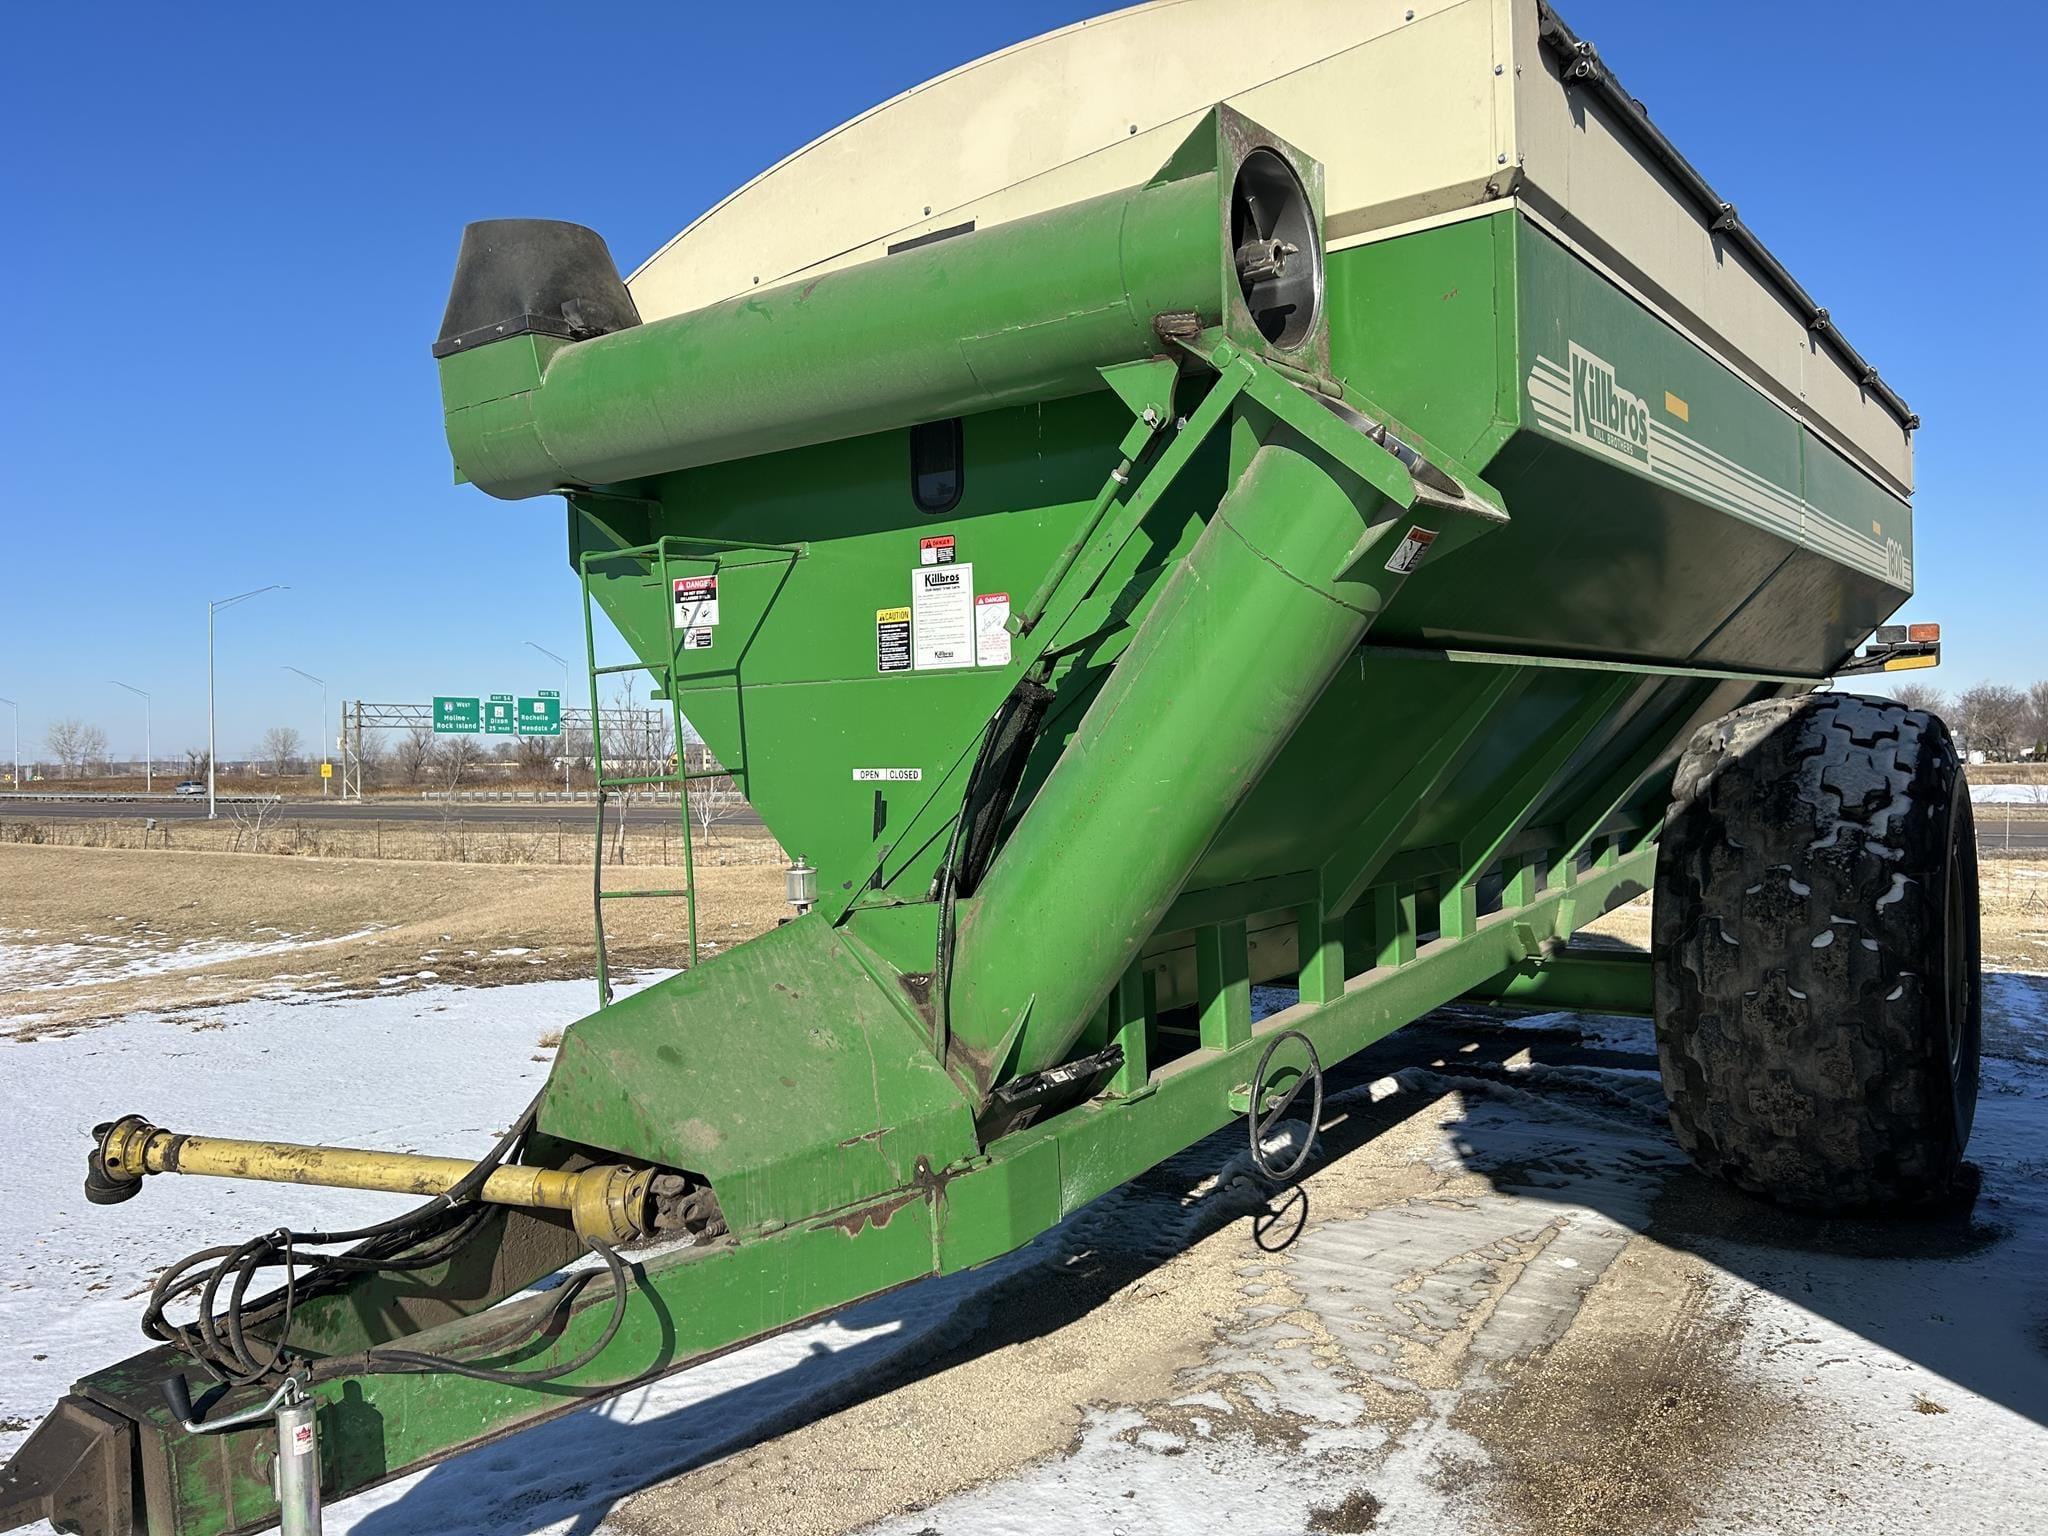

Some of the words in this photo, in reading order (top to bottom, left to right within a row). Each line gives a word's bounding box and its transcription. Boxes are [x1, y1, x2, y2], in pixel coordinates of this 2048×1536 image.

[1572, 352, 1648, 446] Killbros
[1607, 433, 1634, 455] BROTHERS
[925, 573, 960, 587] Killbros
[984, 596, 1007, 604] DANGER
[885, 610, 909, 621] CAUTION
[860, 770, 879, 779] OPEN
[889, 770, 919, 779] CLOSED
